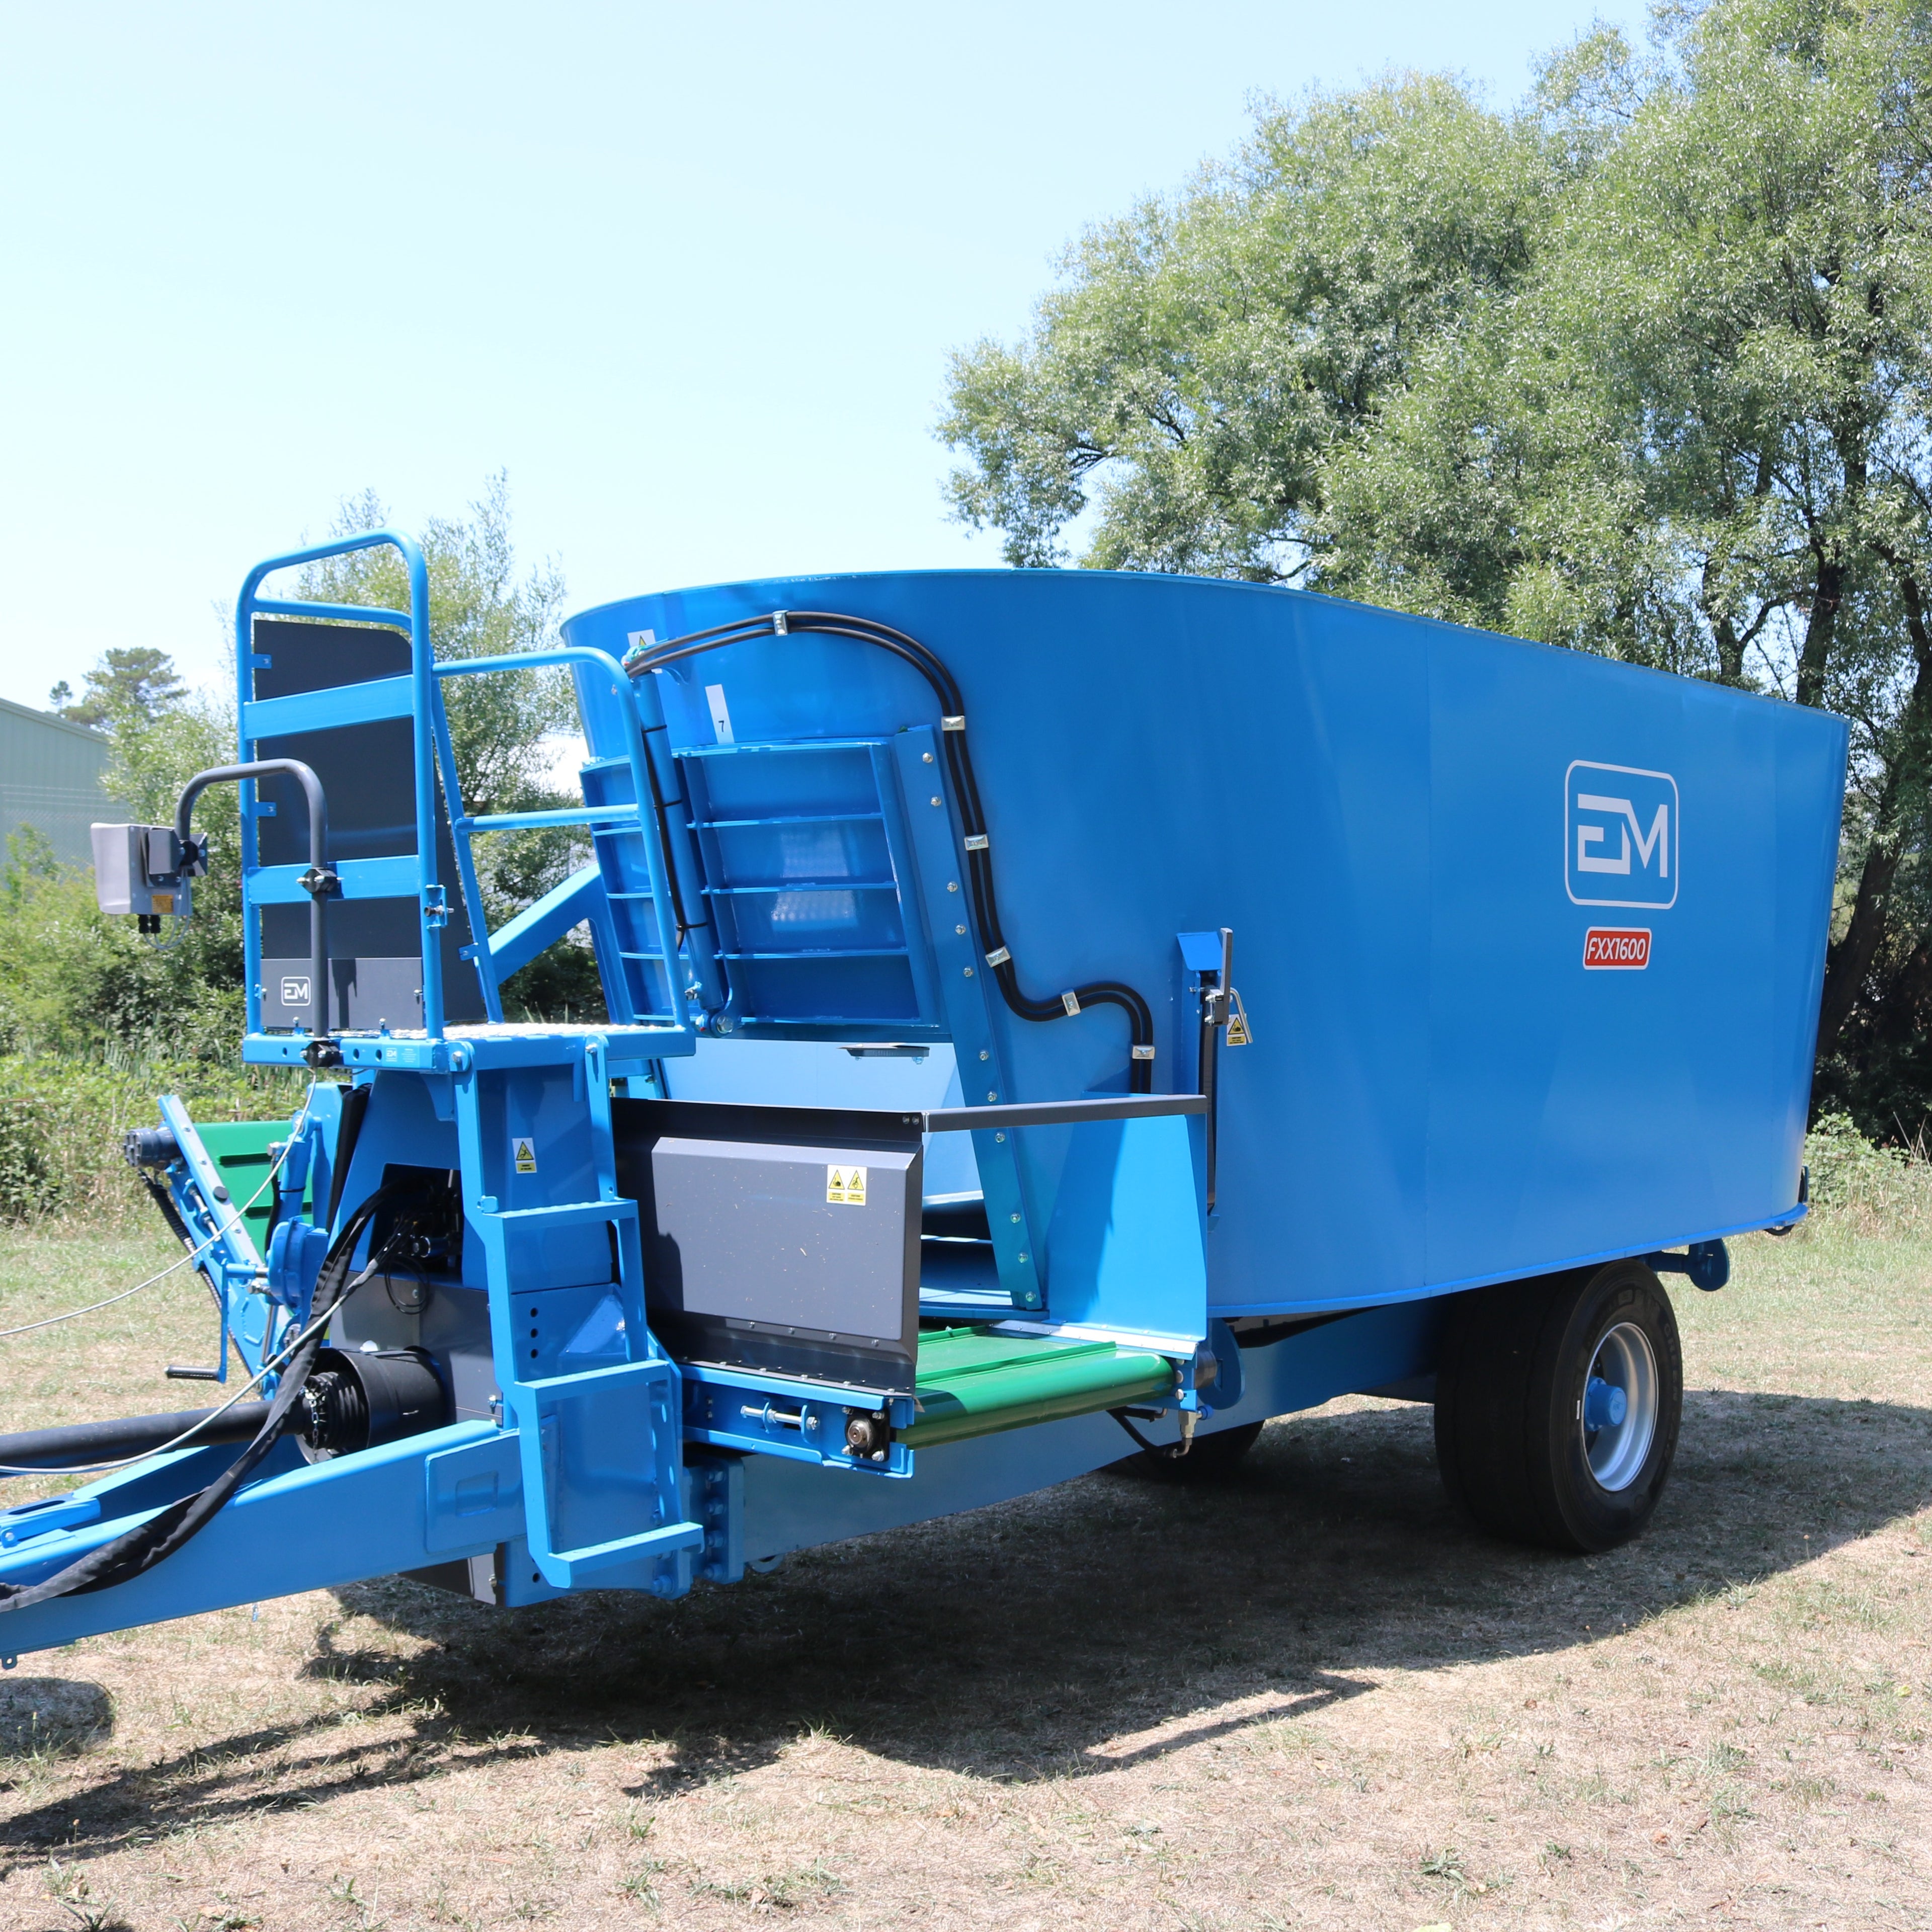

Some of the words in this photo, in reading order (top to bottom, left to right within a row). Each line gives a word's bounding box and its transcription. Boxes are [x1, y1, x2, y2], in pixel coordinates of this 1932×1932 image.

[718, 720, 725, 733] 7
[1578, 793, 1668, 878] EM
[1586, 937, 1646, 960] FXX1600
[284, 983, 308, 1000] EM
